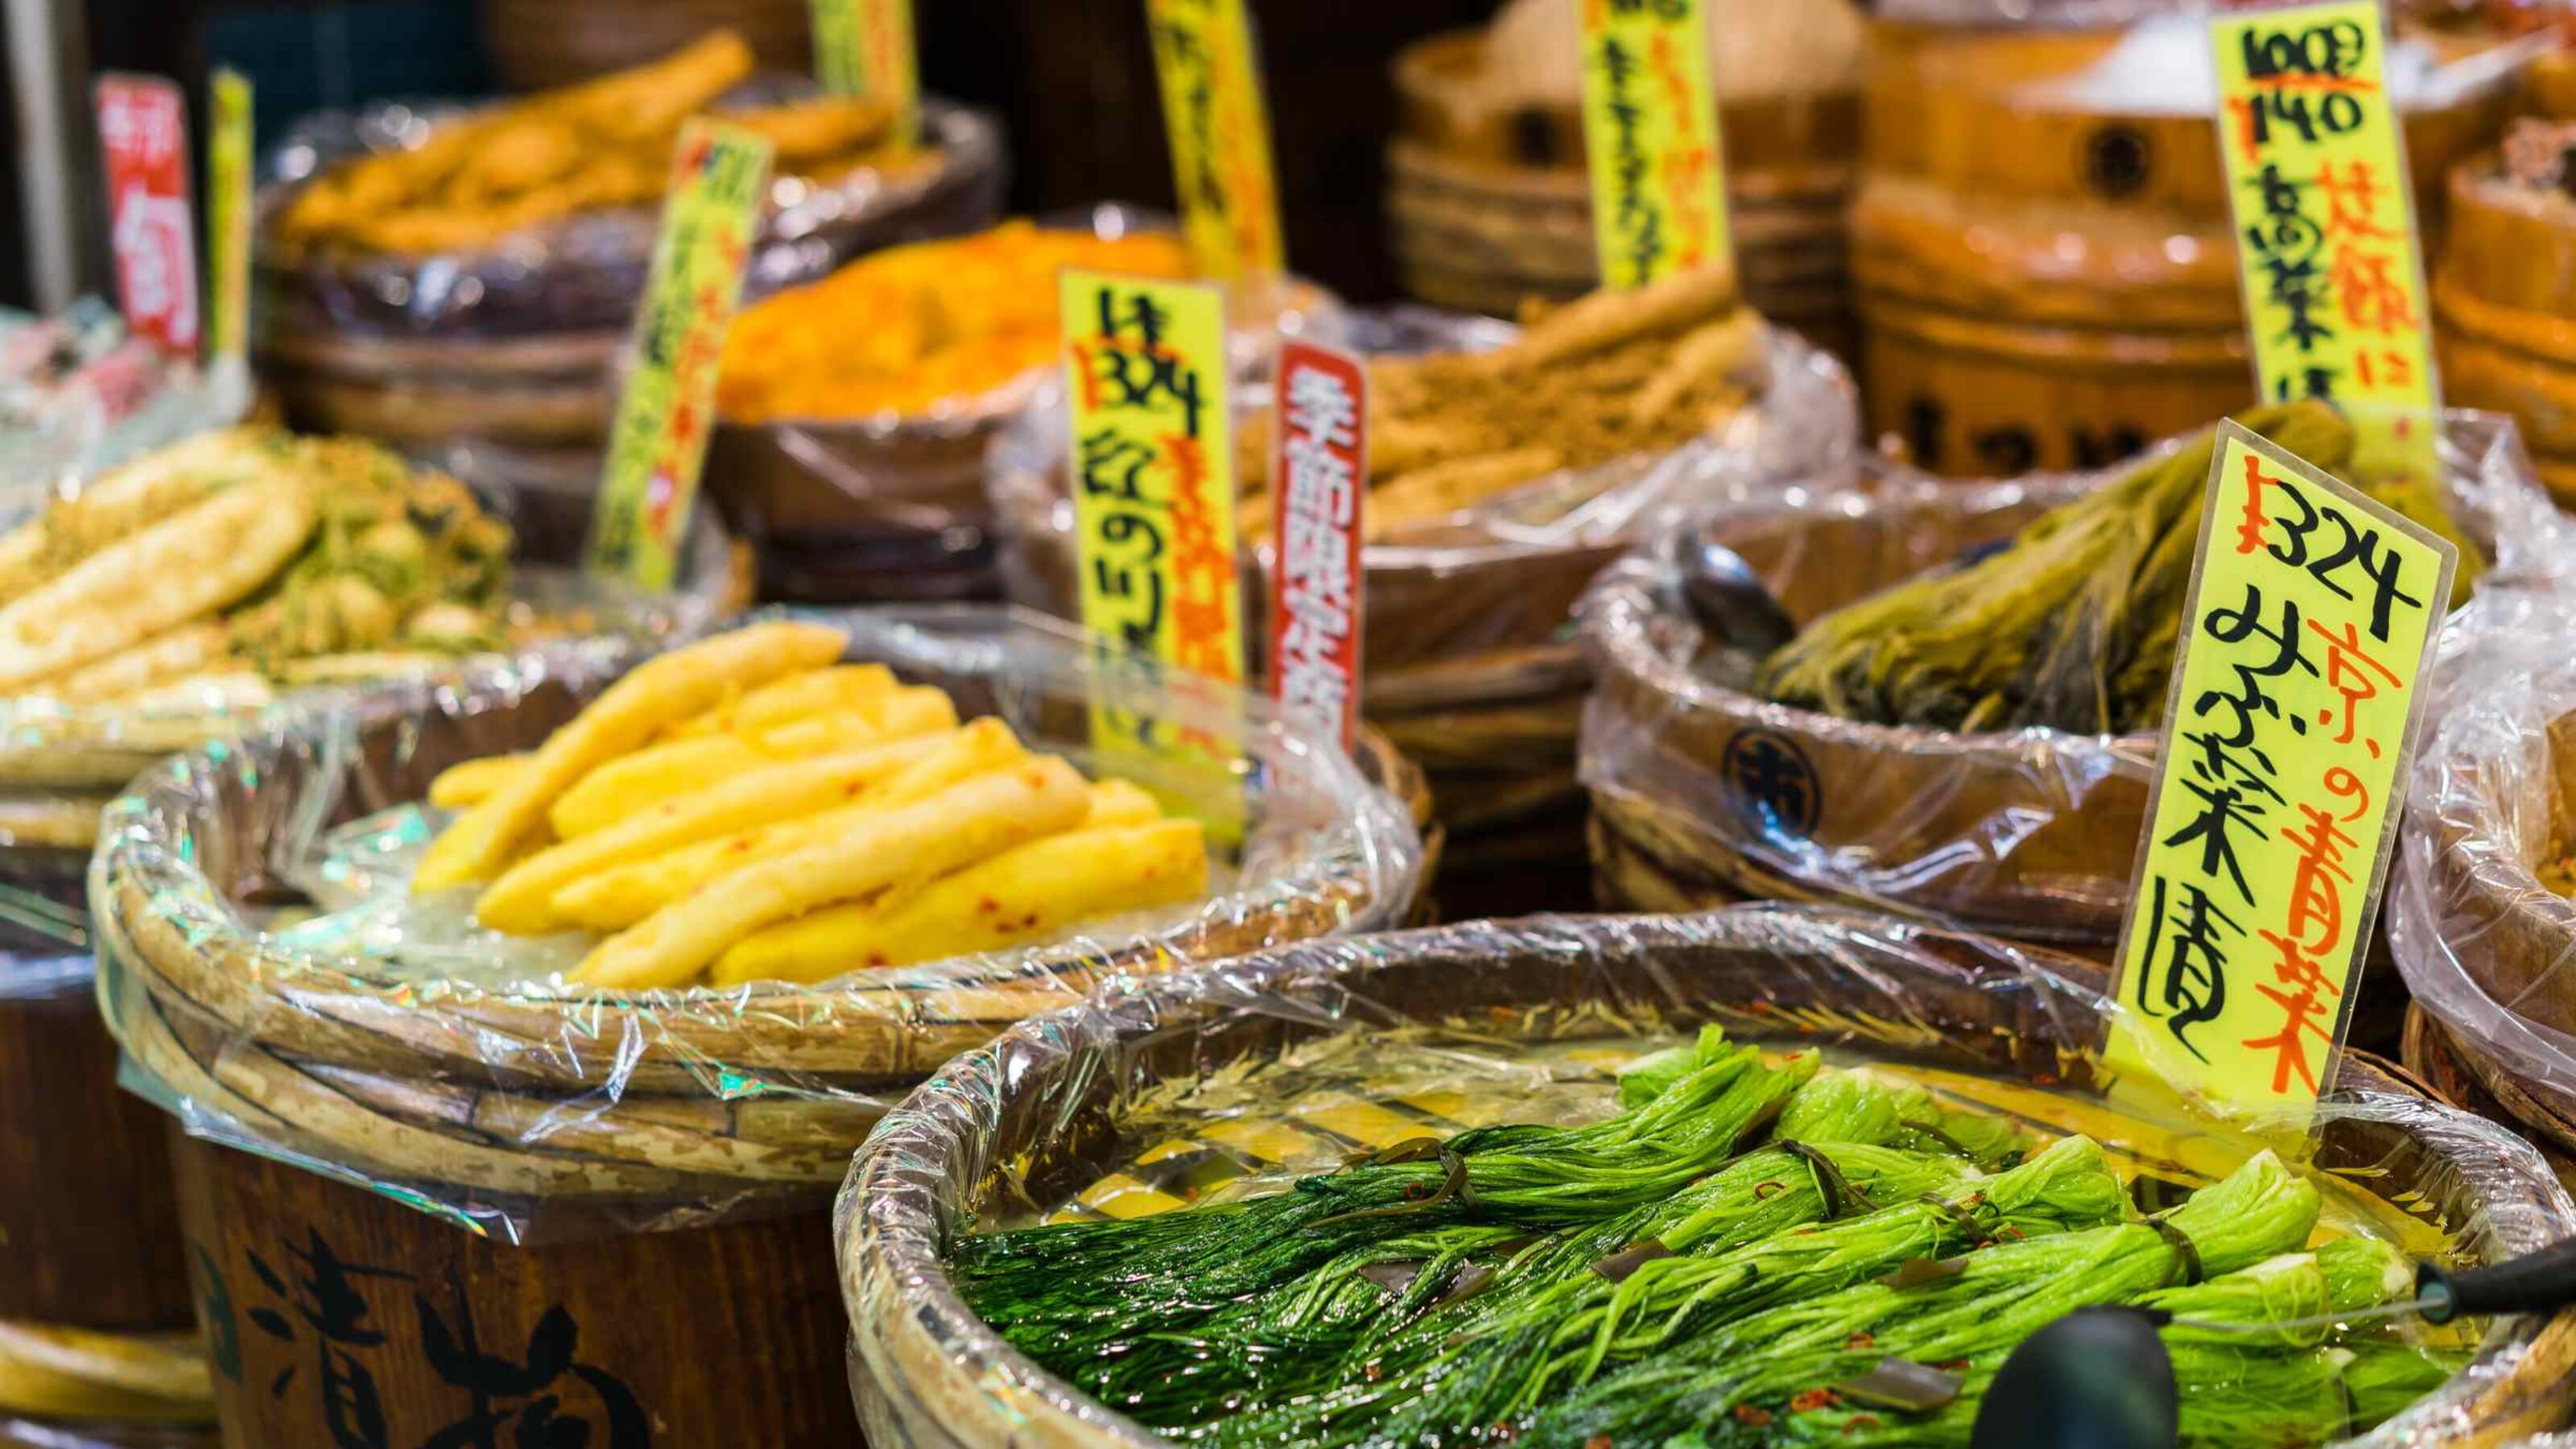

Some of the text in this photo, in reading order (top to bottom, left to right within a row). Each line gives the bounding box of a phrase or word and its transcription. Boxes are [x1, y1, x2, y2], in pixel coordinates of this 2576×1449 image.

[2137, 582, 2319, 1066] みぶ菜漬
[2241, 617, 2402, 1098] 京の青菜
